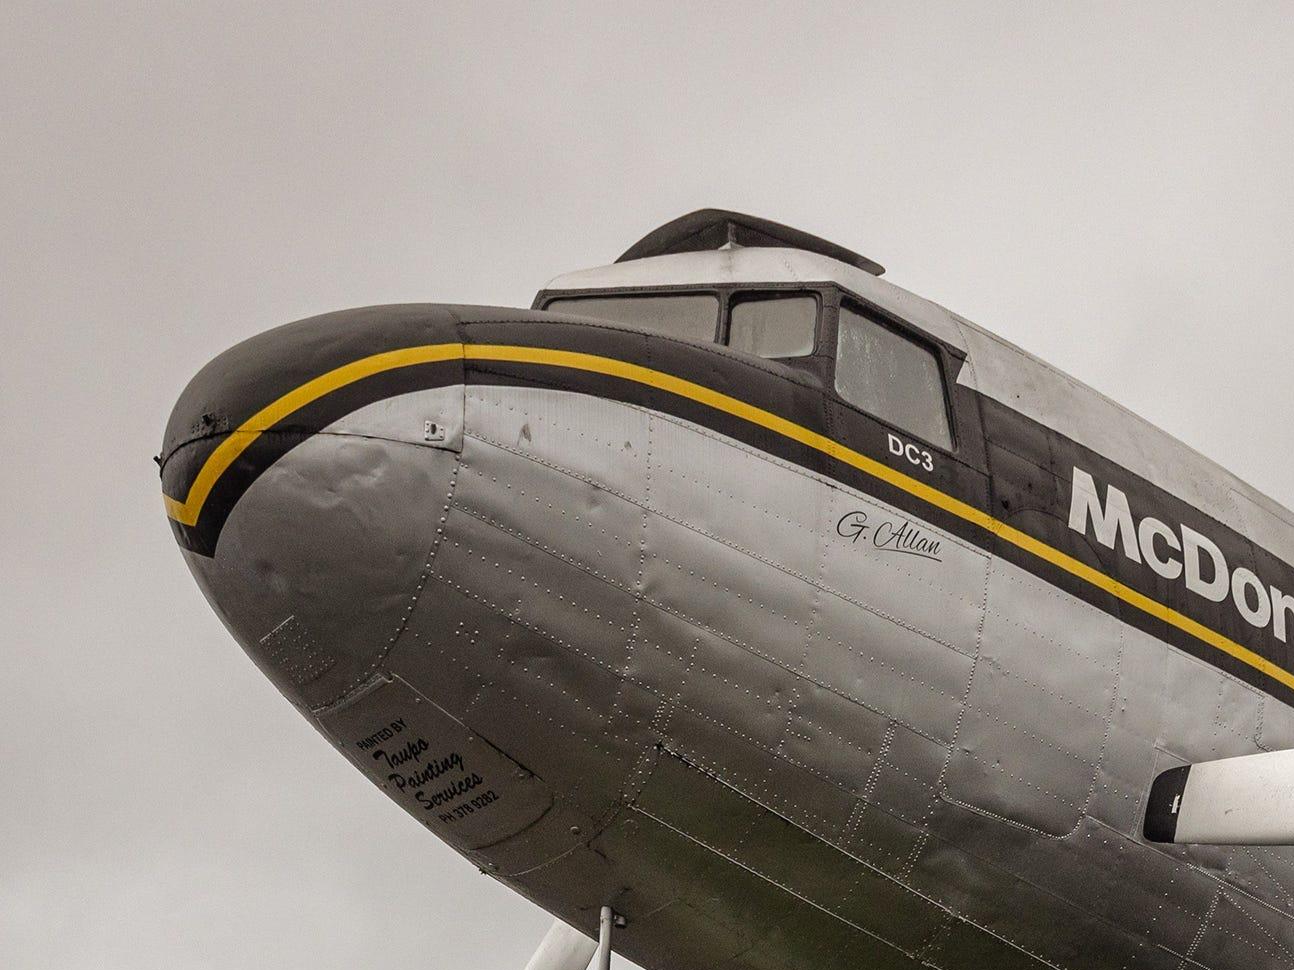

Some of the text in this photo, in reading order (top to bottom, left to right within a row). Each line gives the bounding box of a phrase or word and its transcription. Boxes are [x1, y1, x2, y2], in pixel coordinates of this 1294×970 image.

[887, 433, 934, 472] DC3
[873, 521, 941, 556] Allan
[356, 717, 408, 751] PAINTED BY
[372, 737, 430, 769] Taupo
[388, 751, 465, 793] Painting
[415, 772, 484, 810] Services
[438, 811, 455, 824] PH
[455, 802, 475, 819] 378
